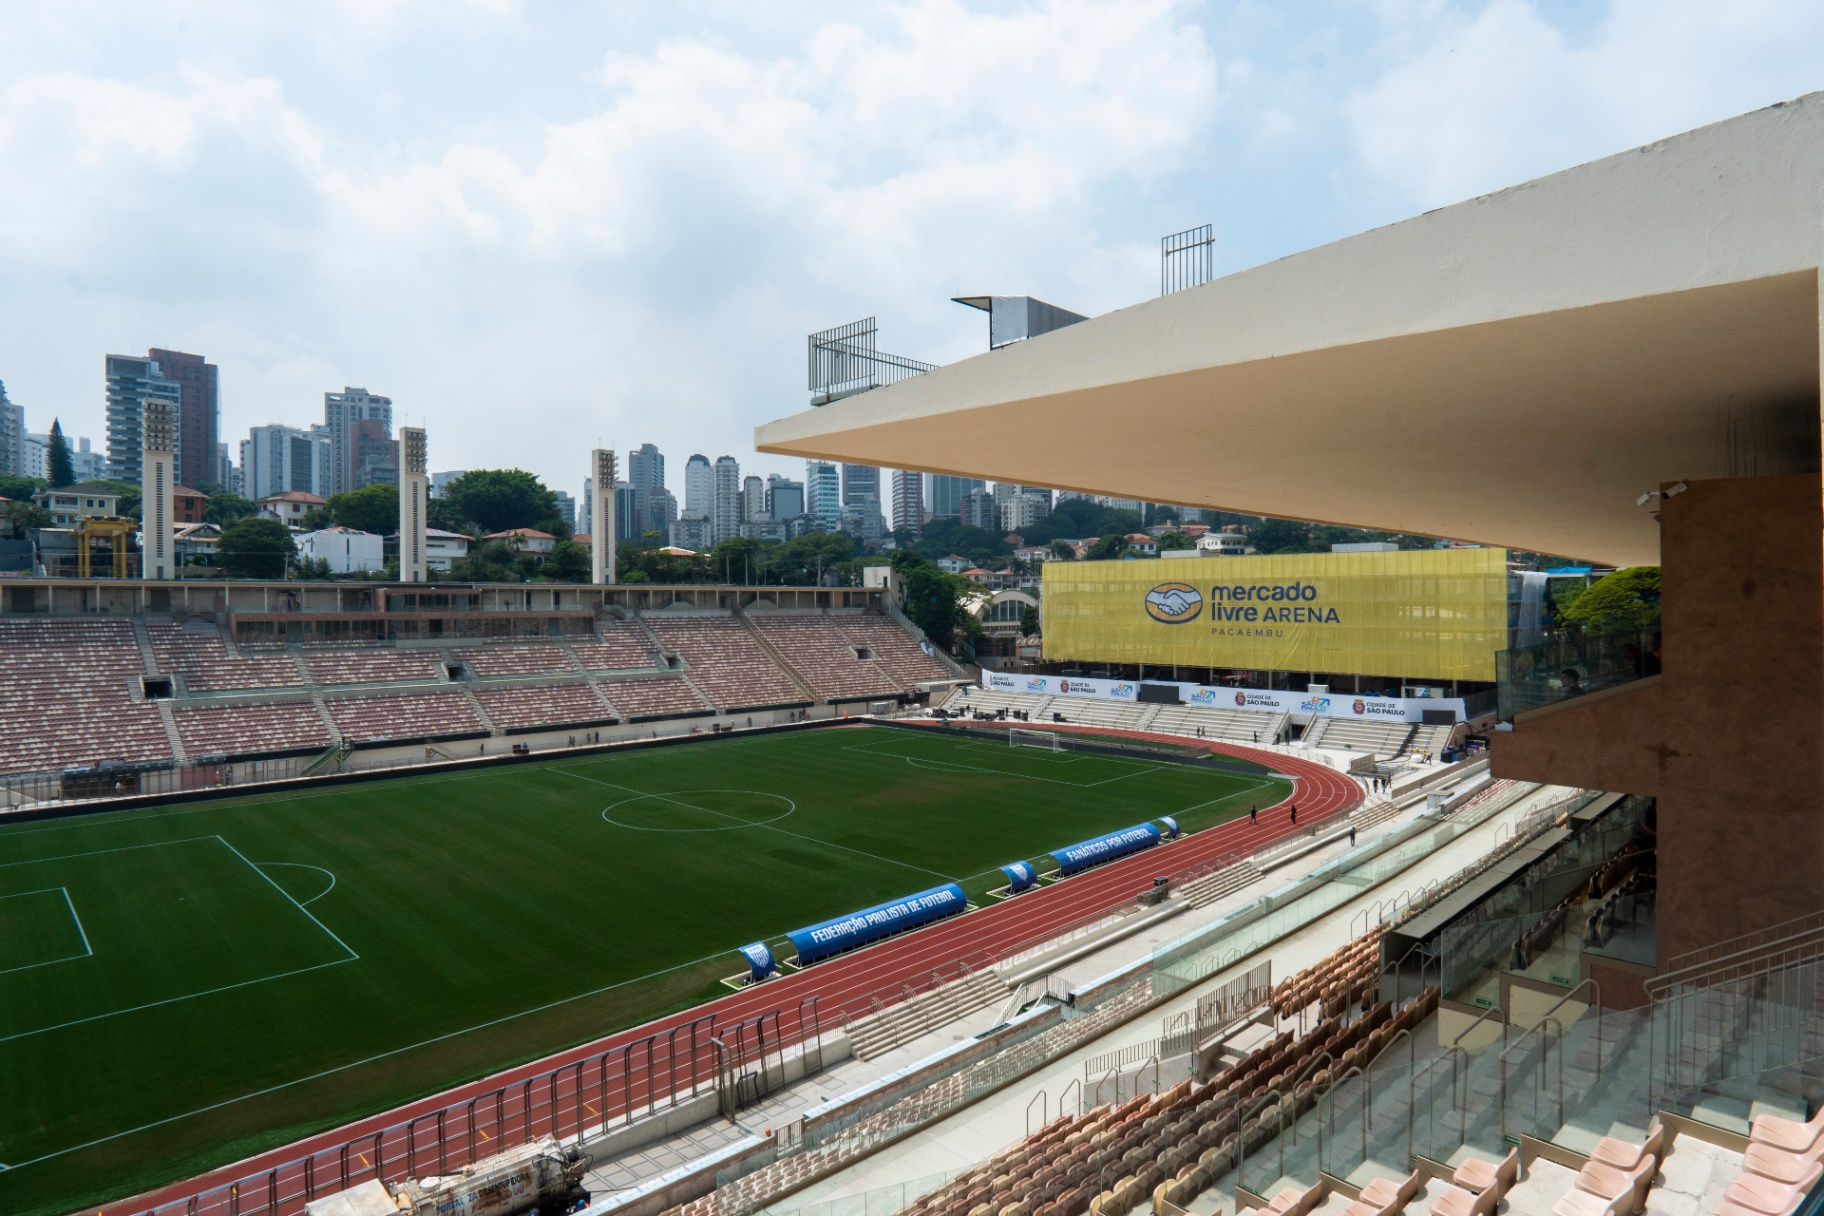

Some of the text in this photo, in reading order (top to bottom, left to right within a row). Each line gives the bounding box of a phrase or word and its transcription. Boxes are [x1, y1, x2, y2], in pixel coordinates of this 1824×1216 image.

[1211, 581, 1317, 601] mercado
[1211, 602, 1341, 624] livre ARENA
[1211, 627, 1284, 638] PACAEMBU
[1382, 708, 1406, 716] PAULO
[1066, 827, 1152, 862] FANÁTICOS POR FUTEBOL
[810, 889, 956, 944] FEDERAÇÃO PAULISTA DE FUTEBOL
[478, 1171, 531, 1198] DESENTUPIDORA
